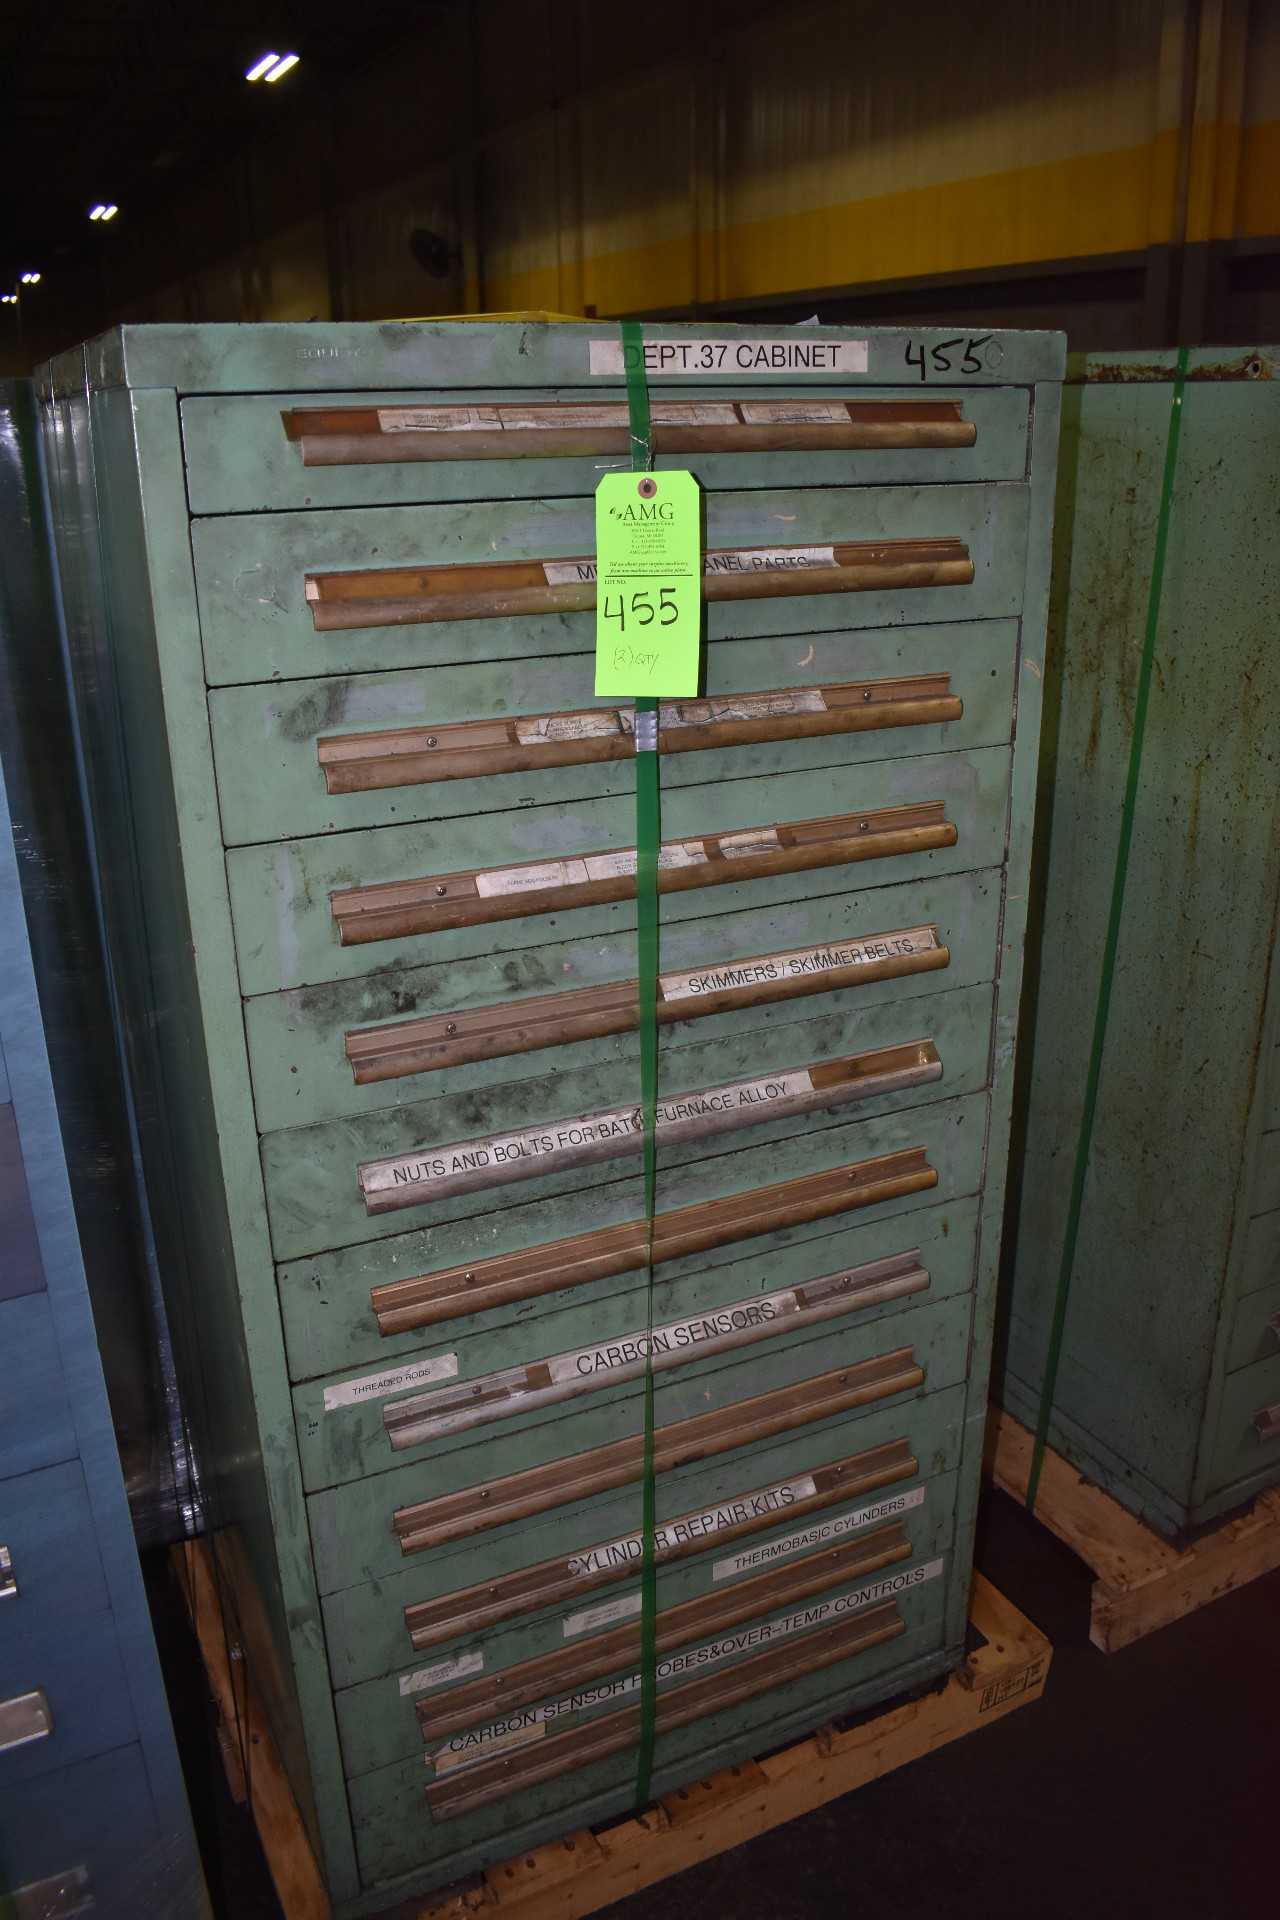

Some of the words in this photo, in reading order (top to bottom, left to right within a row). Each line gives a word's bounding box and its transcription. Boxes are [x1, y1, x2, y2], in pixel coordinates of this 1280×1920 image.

[736, 344, 842, 369] CABINET
[905, 334, 994, 381] 455
[622, 502, 674, 521] AMG
[752, 556, 809, 570] PARTS
[603, 587, 679, 632] 455
[688, 963, 778, 993] SKIMMERS
[789, 948, 863, 974] SKIMMER
[864, 938, 914, 960] BELTS
[393, 1159, 446, 1184] NUTS
[451, 1150, 490, 1173] AND
[493, 1136, 554, 1163] BOLTS
[557, 1126, 595, 1150] FOR
[656, 1094, 734, 1124] FURNACE
[738, 1081, 787, 1106] ALLOY
[576, 1332, 671, 1375] CARBON
[674, 1302, 776, 1346] SENSORS
[352, 1376, 403, 1395] THREADED
[404, 1368, 431, 1381] RODS
[567, 1531, 670, 1575] CYLINDR
[673, 1504, 750, 1544] REPAIR
[750, 1486, 796, 1517] KITS
[734, 1526, 831, 1569] THERMOBASIC
[833, 1498, 905, 1533] CYLINDERS
[450, 1710, 537, 1752] CARBON
[543, 1679, 625, 1720] SENSOR
[834, 1568, 925, 1612] CONTROLS
